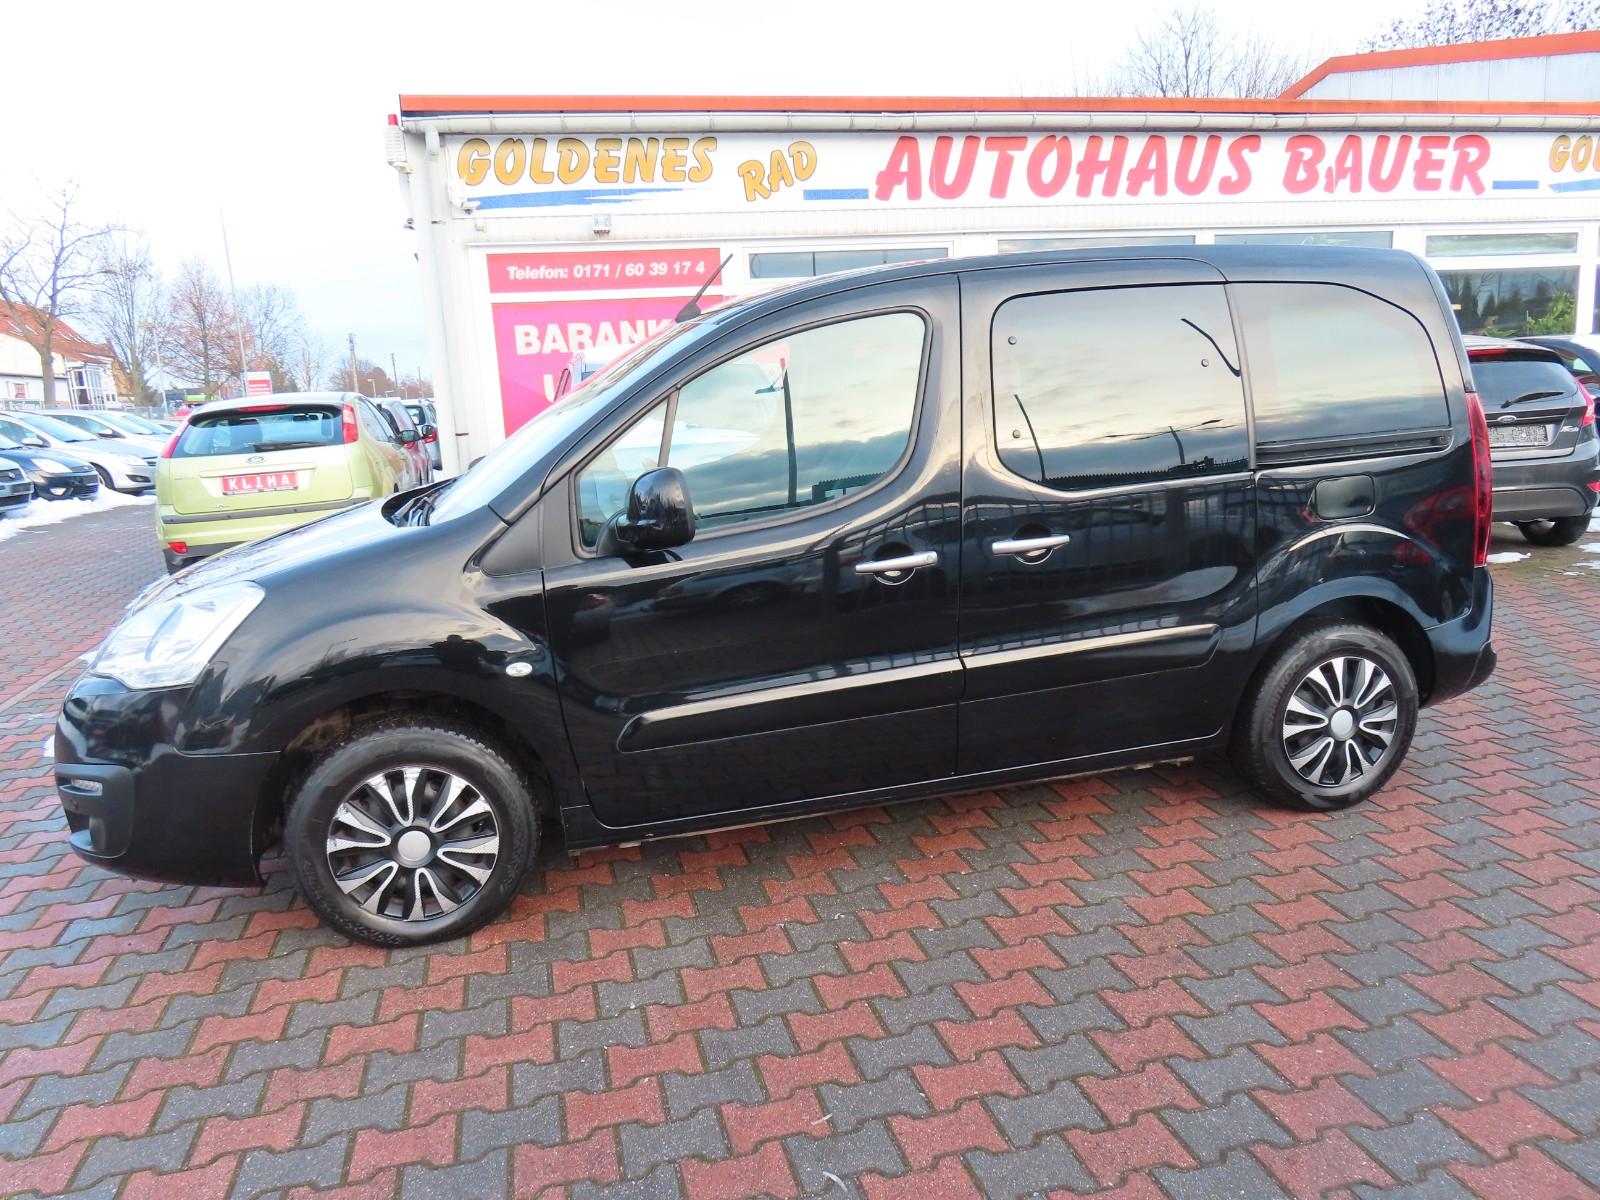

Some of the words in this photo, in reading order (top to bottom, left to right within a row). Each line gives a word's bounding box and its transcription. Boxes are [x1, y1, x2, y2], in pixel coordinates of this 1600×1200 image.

[457, 137, 718, 186] GOLDENES
[737, 140, 817, 202] RAD
[875, 134, 1261, 201] AUTOHAUS
[1282, 134, 1491, 196] BAUER
[506, 265, 569, 281] Telefon:
[573, 264, 610, 278] 0171
[615, 264, 622, 278] /
[625, 263, 644, 277] 60
[649, 262, 668, 276] 39
